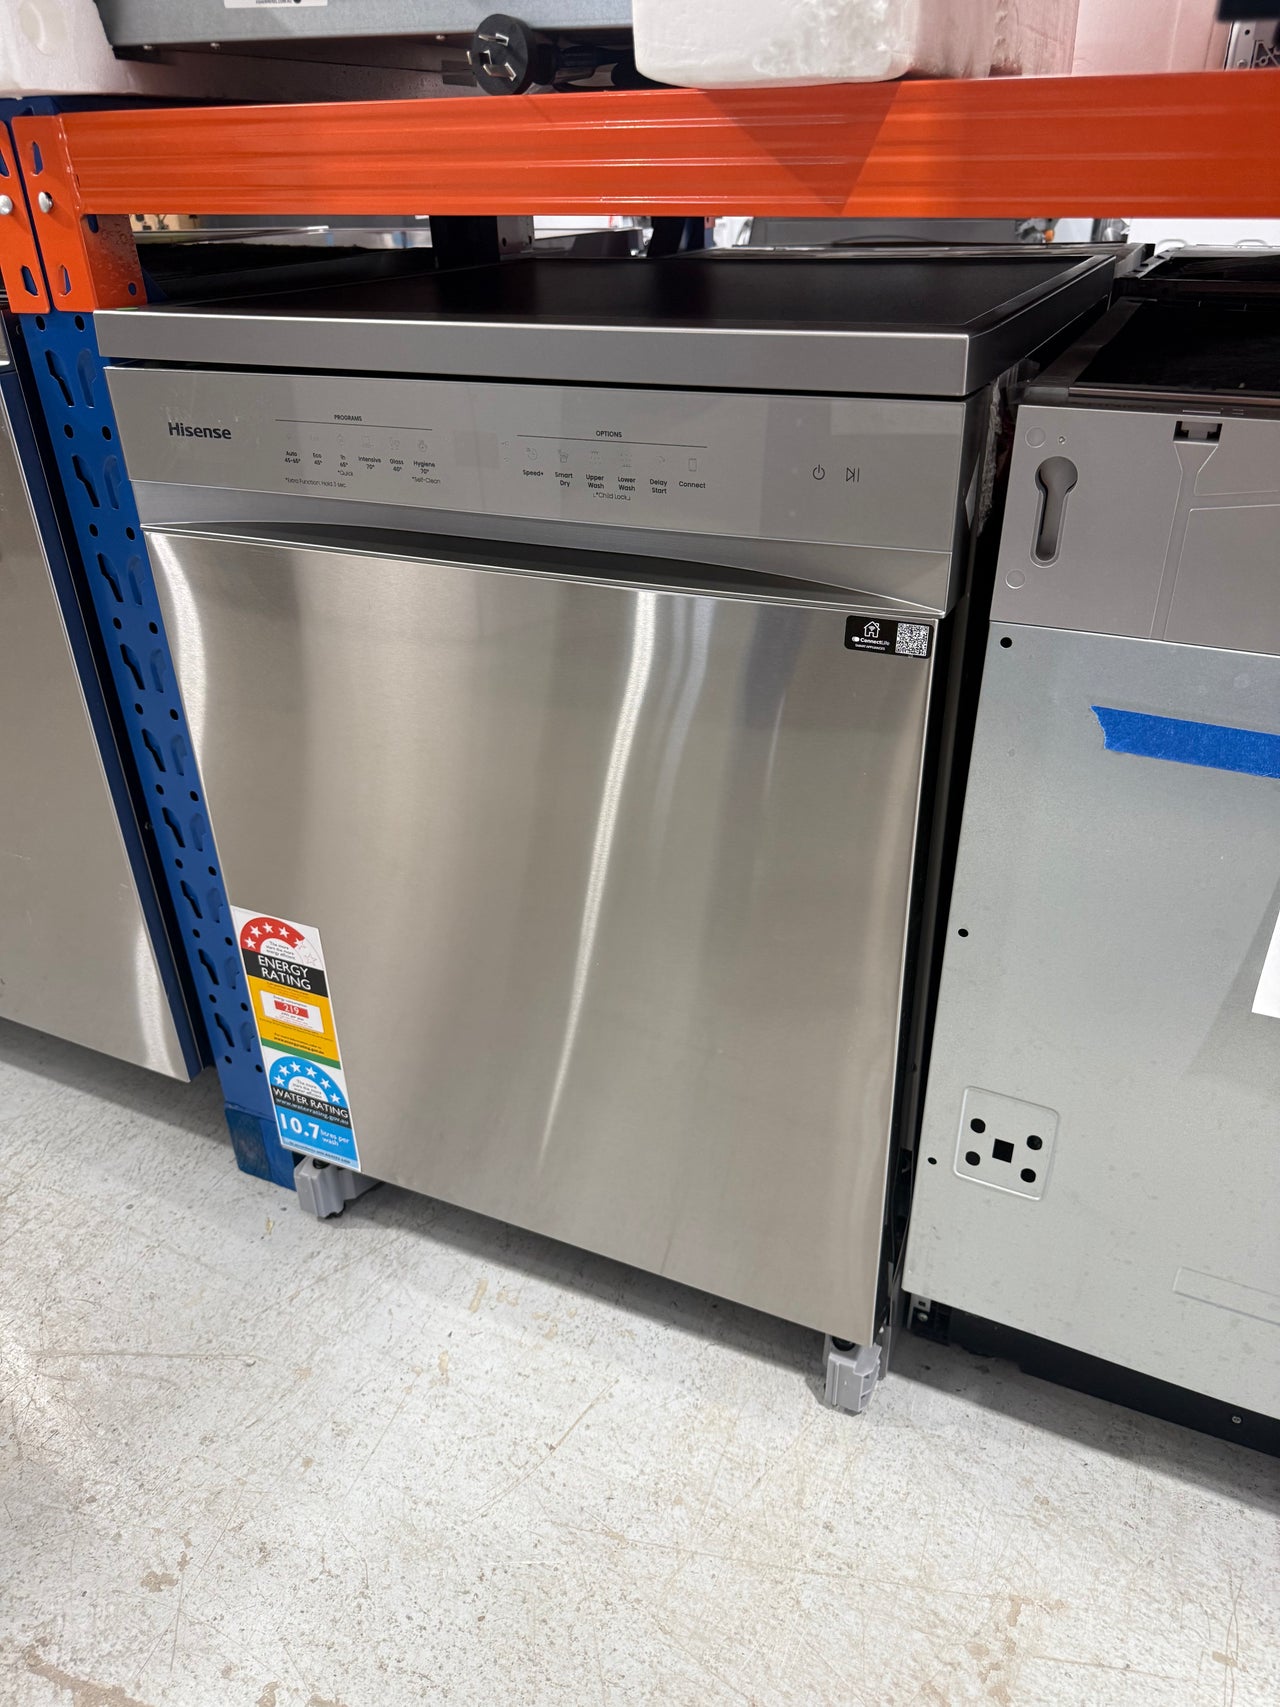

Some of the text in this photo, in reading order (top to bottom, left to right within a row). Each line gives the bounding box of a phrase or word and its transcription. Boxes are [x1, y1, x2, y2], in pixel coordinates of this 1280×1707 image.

[334, 414, 362, 422] PROGRAMS
[168, 422, 232, 440] Hisense
[596, 430, 622, 438] OPTIONS
[650, 478, 667, 486] Delay
[258, 955, 308, 977] ENERGY
[261, 967, 311, 990] RATING
[283, 1003, 299, 1014] 219
[272, 1087, 348, 1118] WATER RATING
[276, 1098, 349, 1125] www.waterrating.gov.au
[280, 1113, 320, 1139] 10.7
[322, 1137, 339, 1146] wash
[338, 1136, 350, 1144] per
